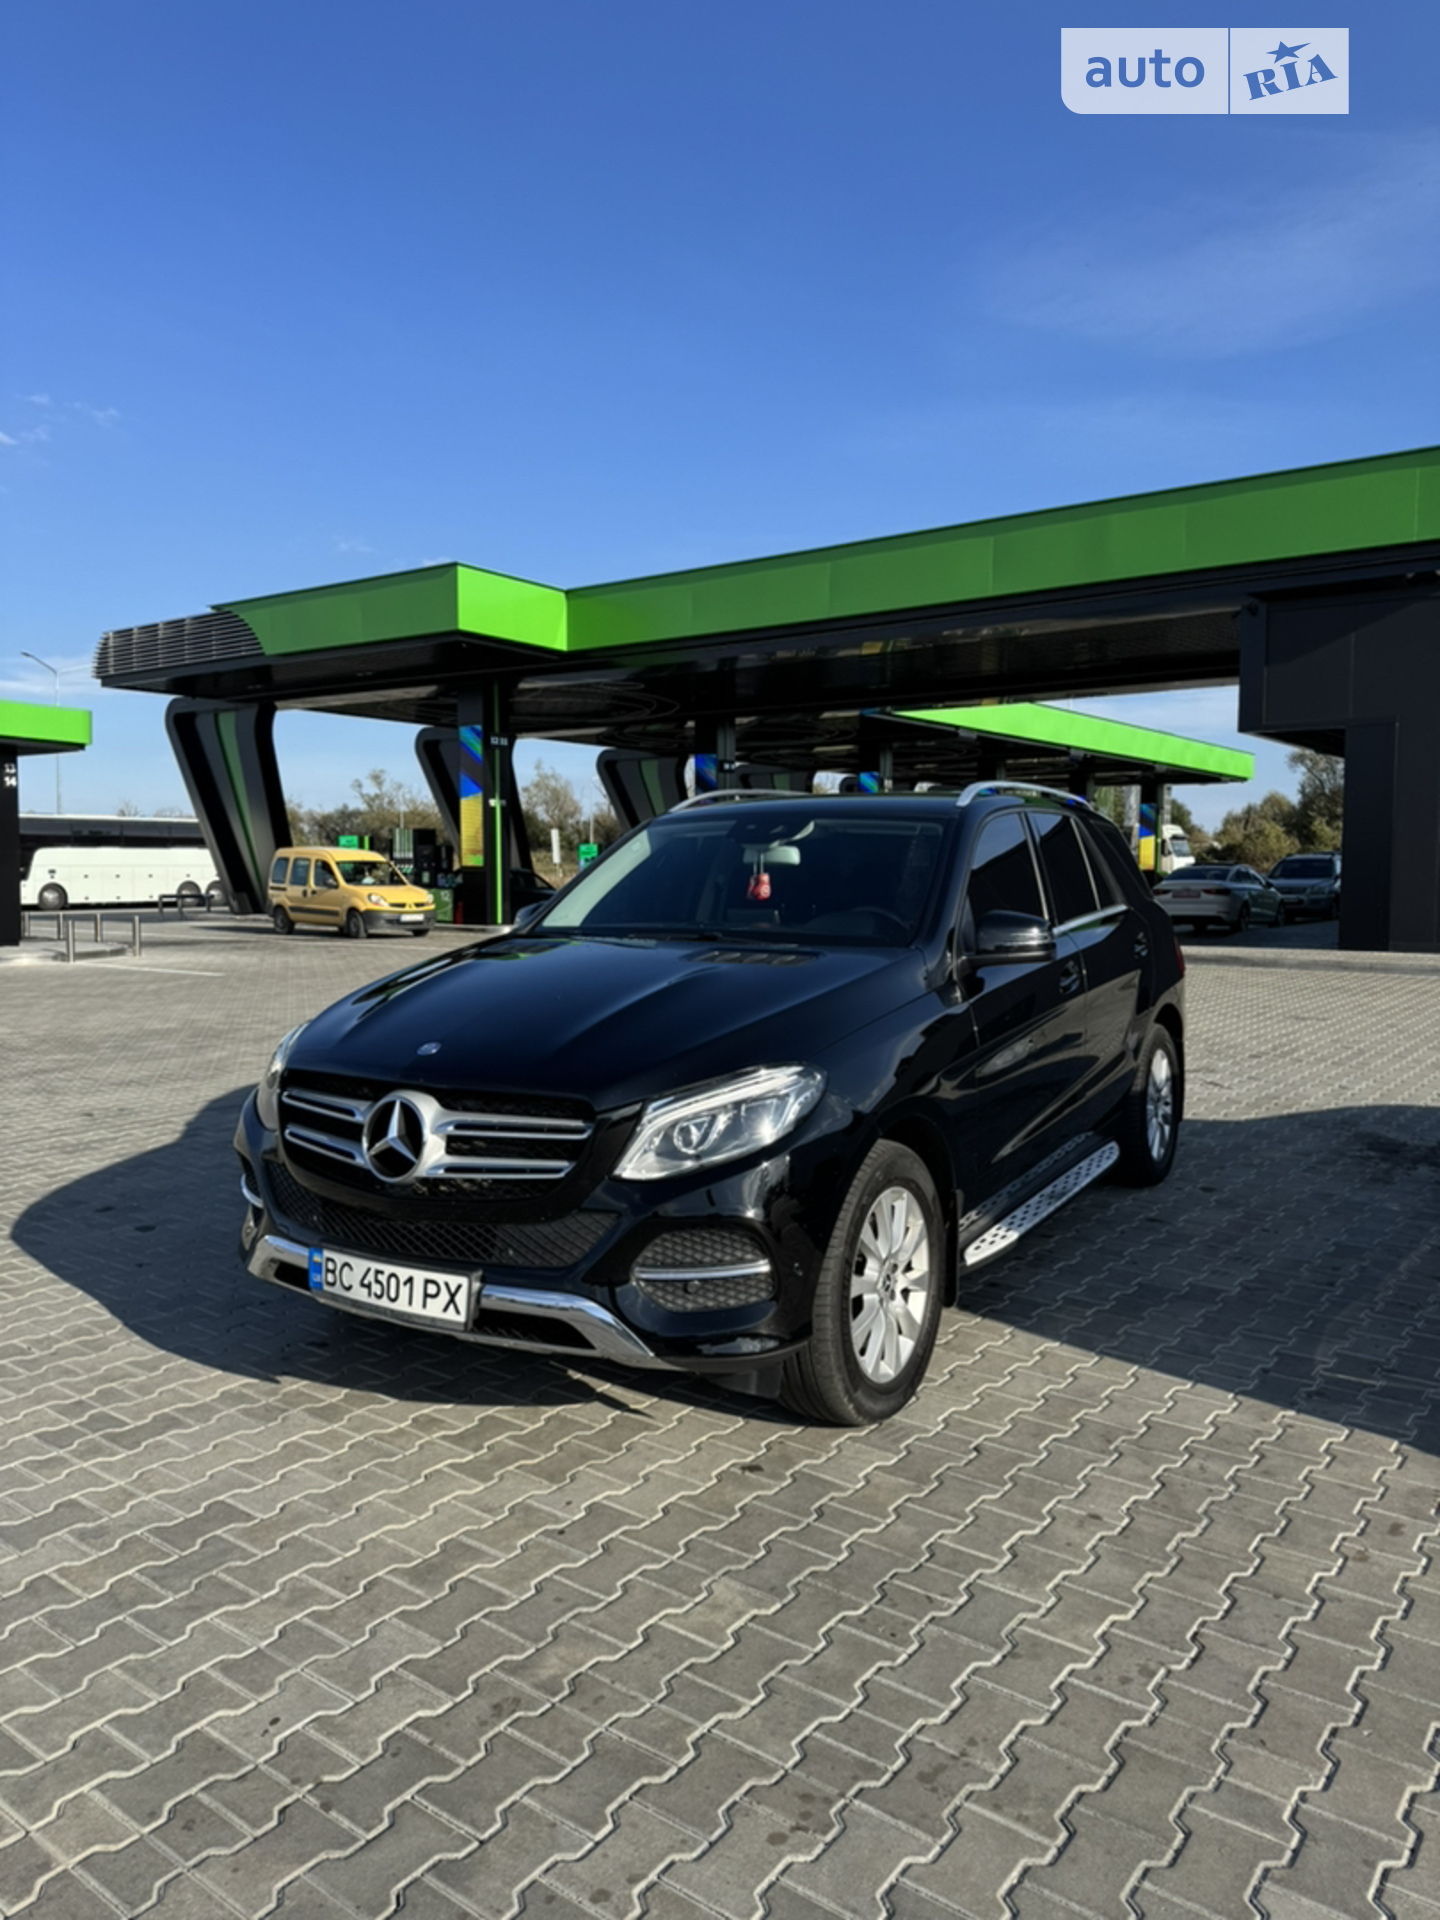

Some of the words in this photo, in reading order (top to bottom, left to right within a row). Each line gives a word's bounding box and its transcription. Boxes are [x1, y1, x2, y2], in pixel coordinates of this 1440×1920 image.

[4, 776, 17, 787] 14
[324, 1257, 354, 1292] BC
[359, 1267, 415, 1307] 4501
[422, 1278, 463, 1316] PX
